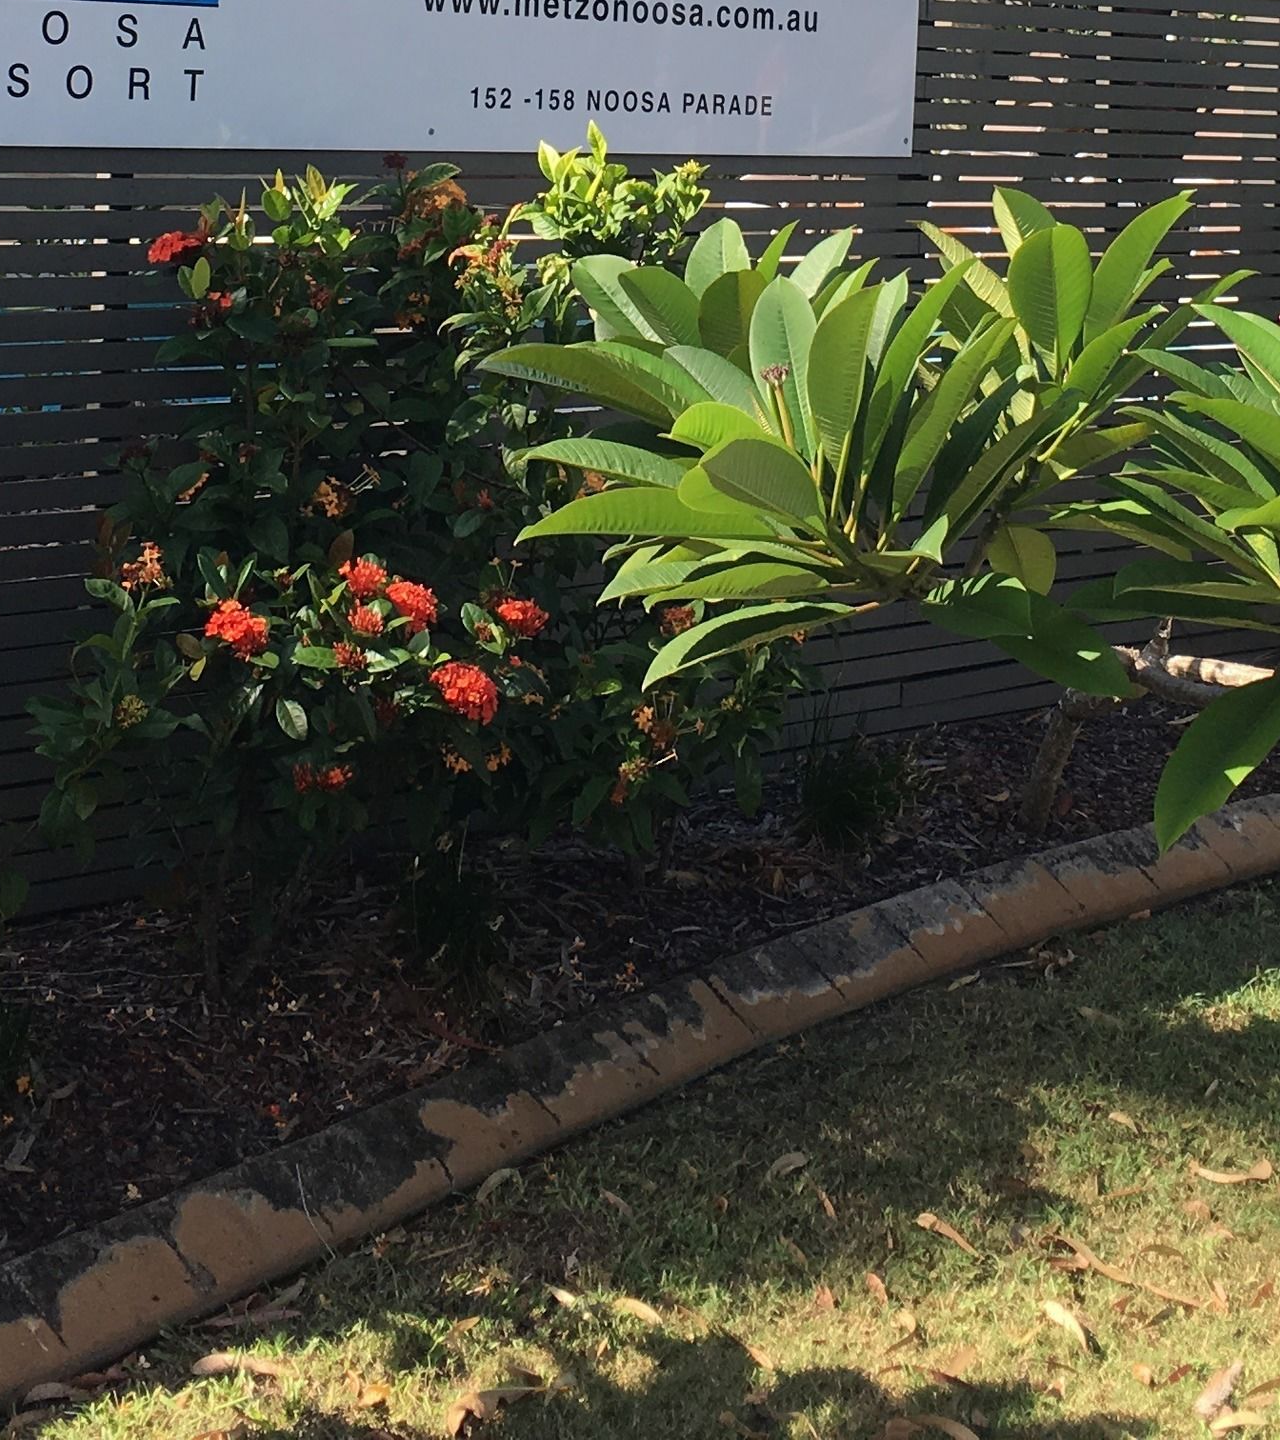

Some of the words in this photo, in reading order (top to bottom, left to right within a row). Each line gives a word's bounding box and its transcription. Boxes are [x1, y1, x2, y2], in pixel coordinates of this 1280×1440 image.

[470, 86, 512, 110] 152
[523, 88, 575, 111] -158
[586, 89, 671, 113] NOOSA
[682, 92, 773, 116] PARADE
